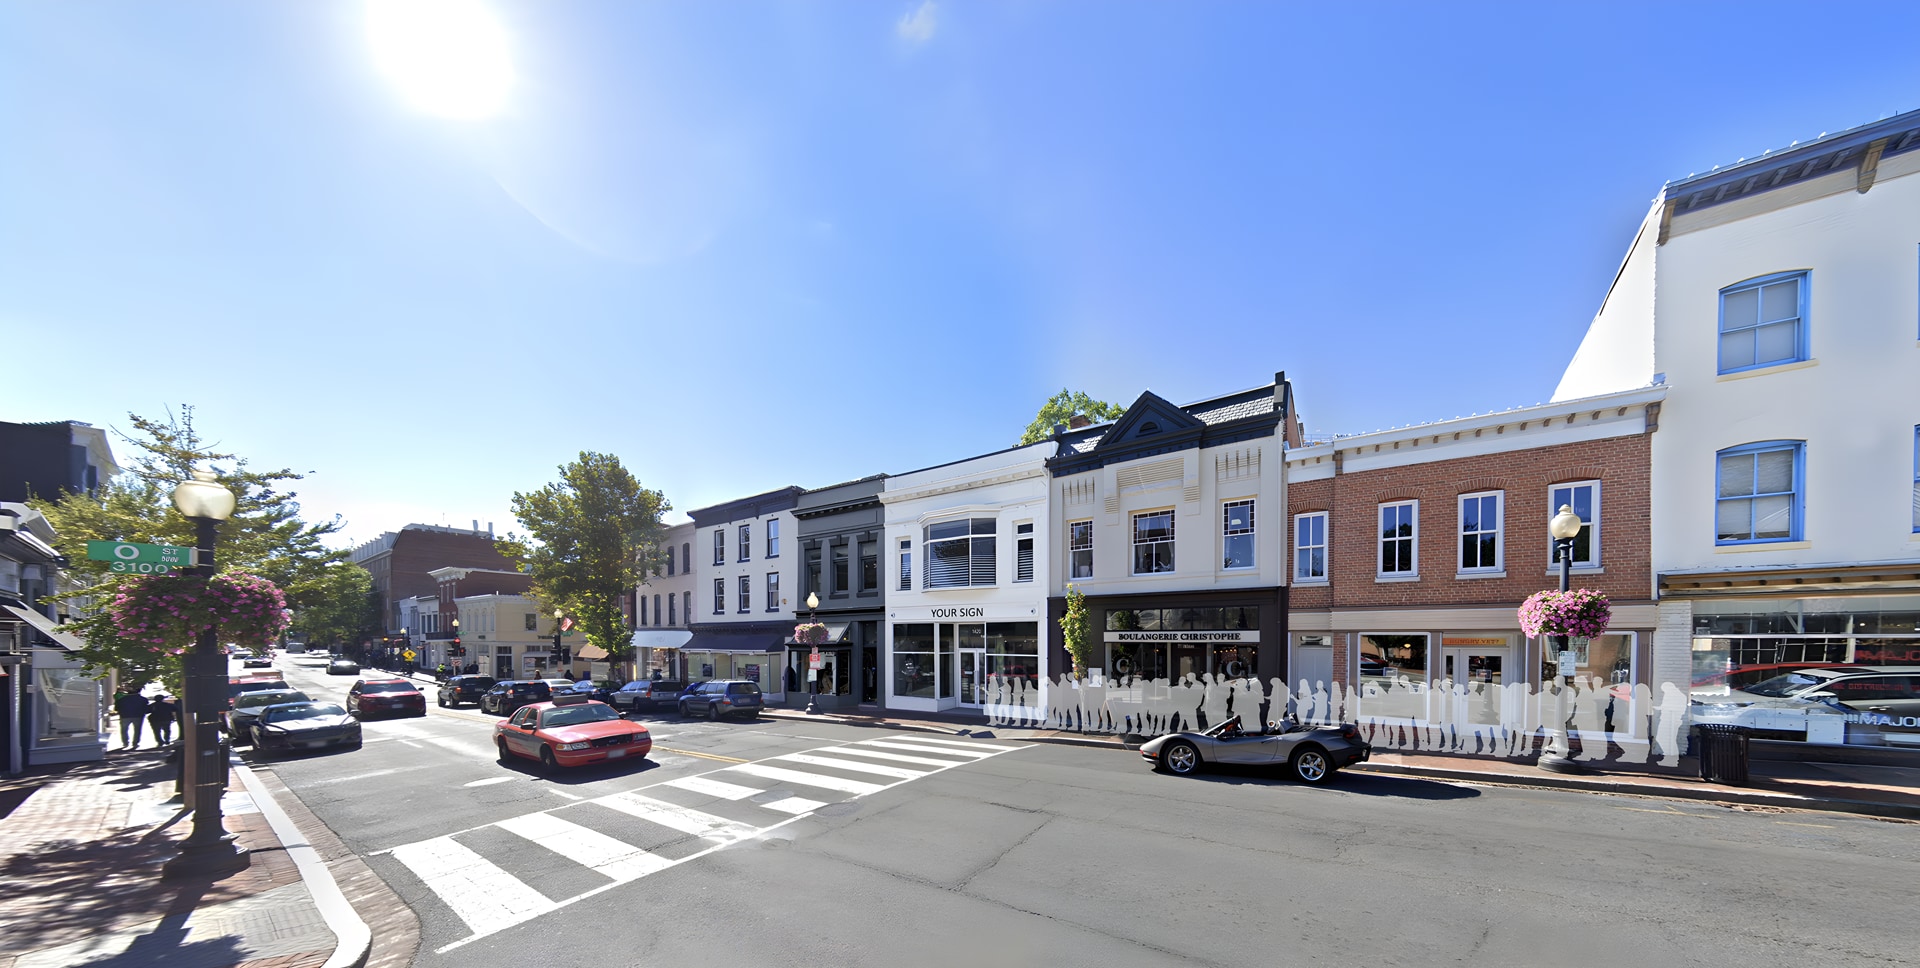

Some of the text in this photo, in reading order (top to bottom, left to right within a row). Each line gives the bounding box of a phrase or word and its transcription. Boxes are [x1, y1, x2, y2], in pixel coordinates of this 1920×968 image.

[114, 545, 139, 560] O
[112, 561, 169, 574] 3100
[931, 607, 984, 618] YOUR SIGN
[1118, 633, 1241, 641] BOULANGERIE CHRISTOPHE
